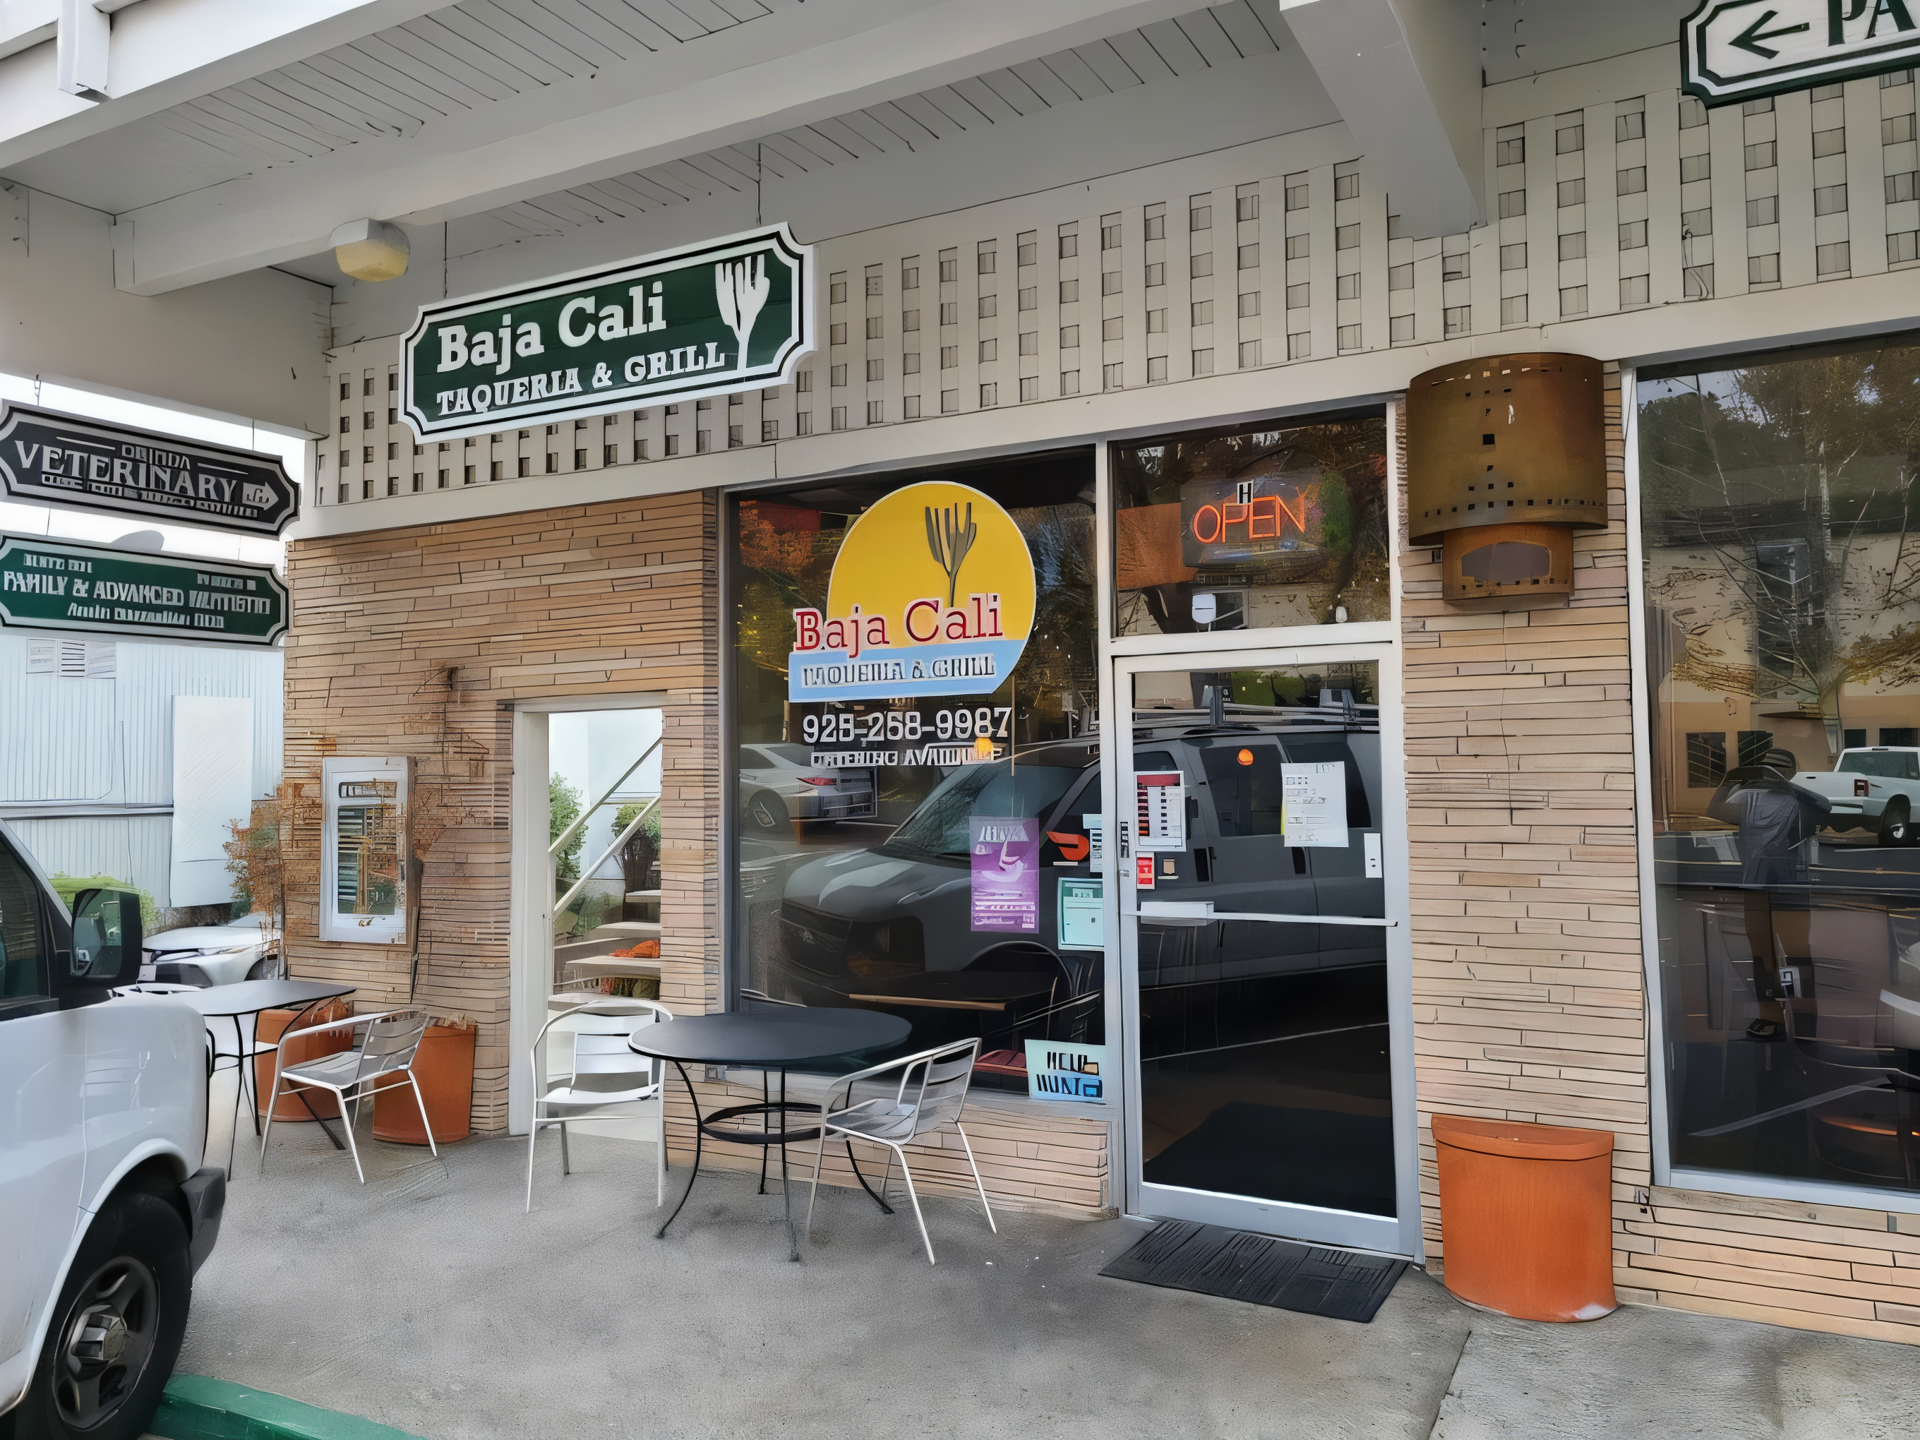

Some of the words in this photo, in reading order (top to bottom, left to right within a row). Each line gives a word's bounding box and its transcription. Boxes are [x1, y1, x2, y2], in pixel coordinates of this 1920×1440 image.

[436, 313, 545, 376] Baja
[558, 280, 668, 348] Cali
[436, 367, 583, 416] TAQUERIA
[591, 361, 613, 389] &
[624, 342, 726, 383] GRILL
[14, 440, 238, 503] VETERINARY
[1193, 494, 1306, 543] OPEN
[795, 604, 890, 658] Baja
[905, 594, 1003, 643] Cali
